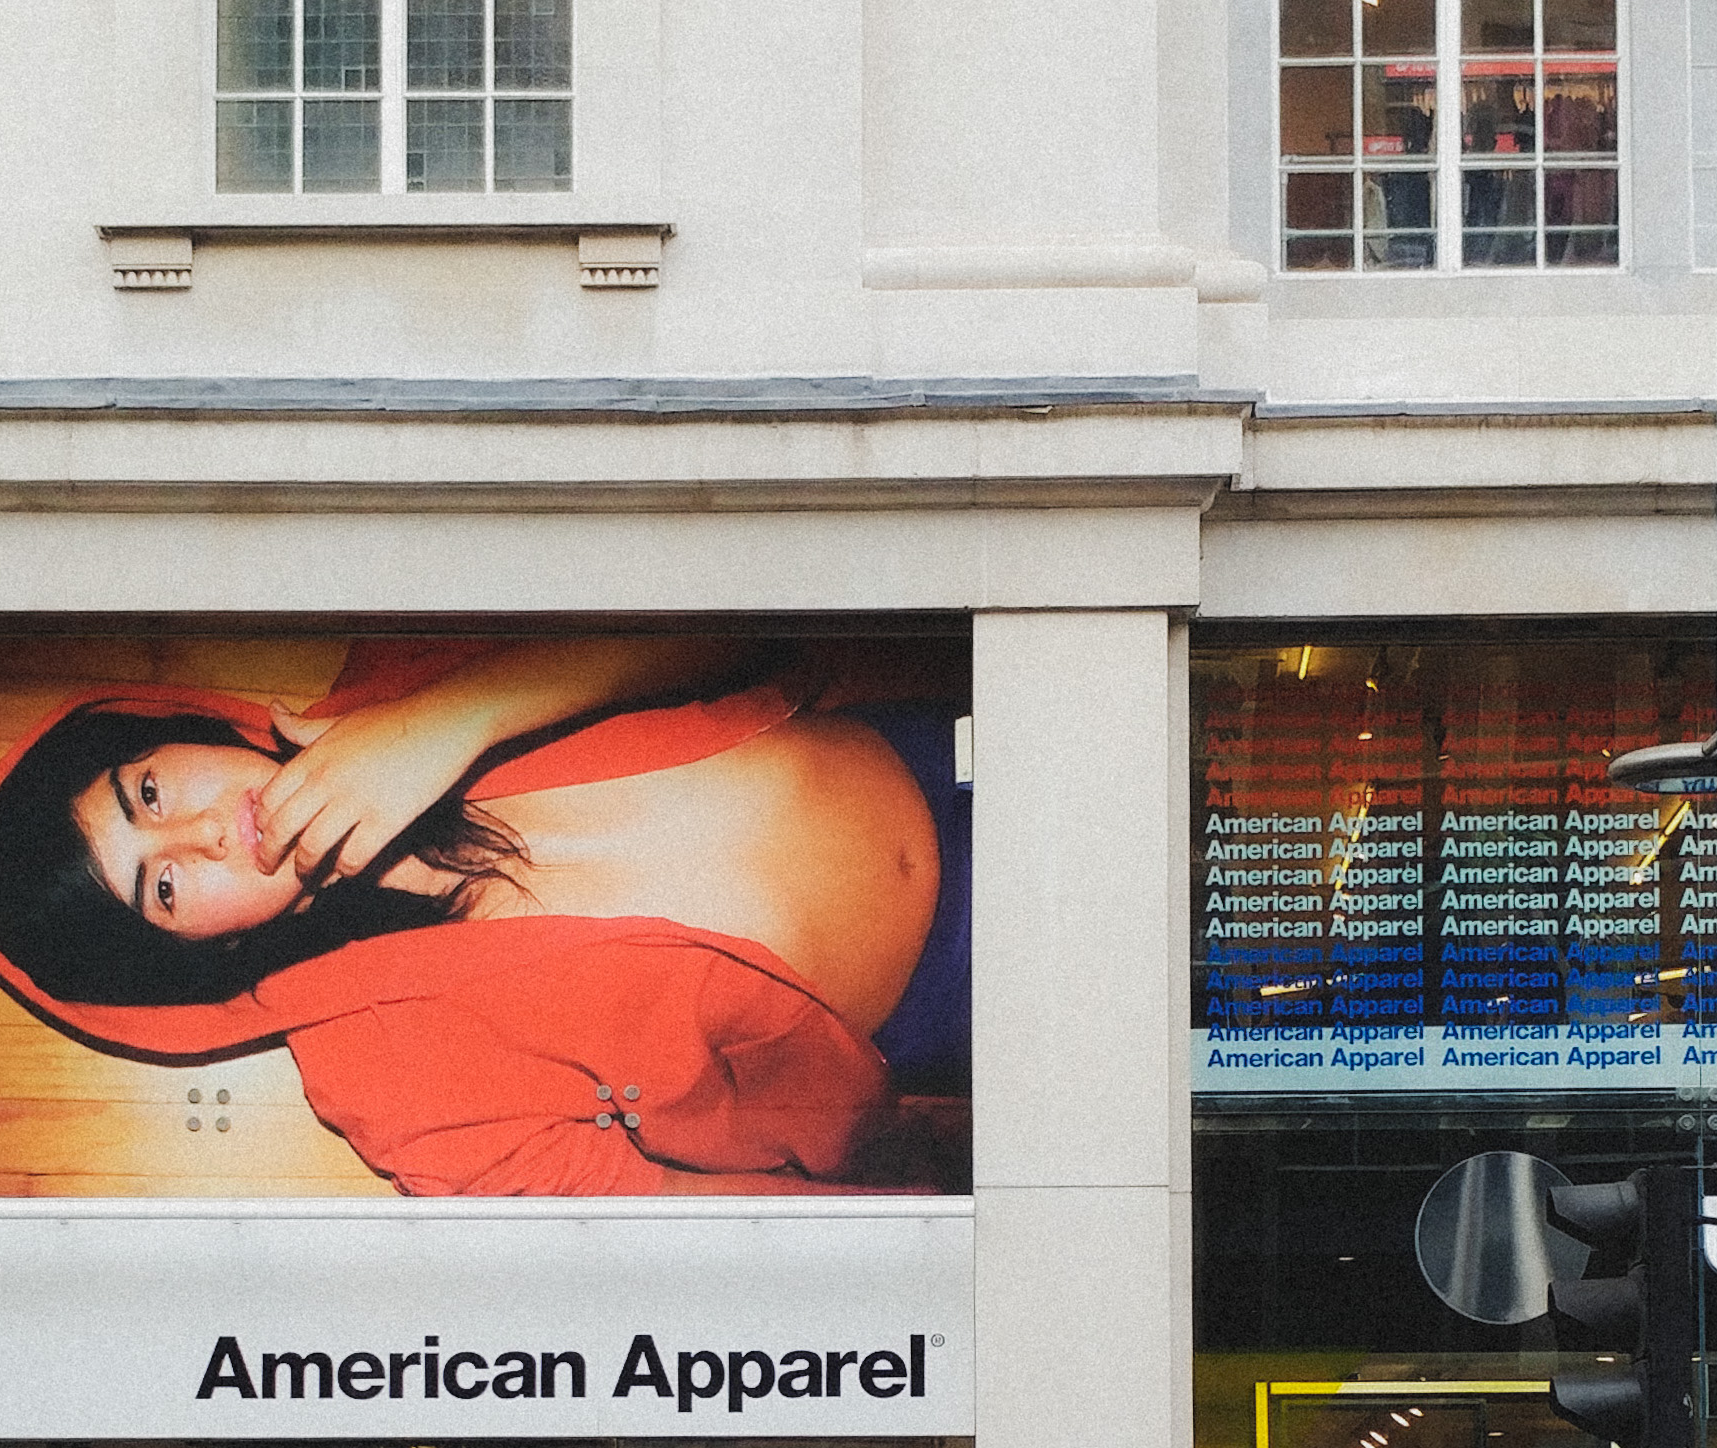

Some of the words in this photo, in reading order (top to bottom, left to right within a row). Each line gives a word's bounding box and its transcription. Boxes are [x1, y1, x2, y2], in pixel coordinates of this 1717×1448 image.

[1205, 812, 1322, 834] American
[1328, 811, 1423, 836] Apparel
[1440, 810, 1558, 831] American
[1564, 809, 1660, 834] Apparel
[1205, 838, 1322, 860] American
[1328, 837, 1423, 862] Apparel
[1440, 836, 1558, 857] American
[1564, 835, 1660, 860] Apparel
[1205, 864, 1322, 886] American
[1329, 863, 1423, 888] Apparel
[1440, 863, 1558, 883] American
[1564, 862, 1660, 886] Apparel
[1206, 891, 1322, 912] American
[1329, 890, 1423, 914] Apparel
[1441, 889, 1558, 910] American
[1565, 888, 1660, 912] Apparel
[1206, 917, 1322, 938] American
[1329, 916, 1423, 940] Apparel
[1441, 915, 1558, 936] American
[1565, 914, 1660, 938] Apparel
[1206, 943, 1323, 964] American
[1330, 942, 1424, 967] Apparel
[1441, 942, 1559, 962] American
[1565, 941, 1661, 965] Apparel
[1441, 968, 1559, 988] American
[1207, 996, 1323, 1016] American
[1330, 995, 1424, 1019] Apparel
[1566, 993, 1661, 1017] Apparel
[1207, 1022, 1323, 1042] American
[1331, 1021, 1424, 1045] Apparel
[1442, 1021, 1559, 1041] American
[1566, 1020, 1661, 1043] Apparel
[1207, 1048, 1323, 1068] American
[1331, 1047, 1424, 1071] Apparel
[1442, 1047, 1559, 1067] American
[1566, 1046, 1661, 1069] Apparel
[195, 1335, 586, 1402] American
